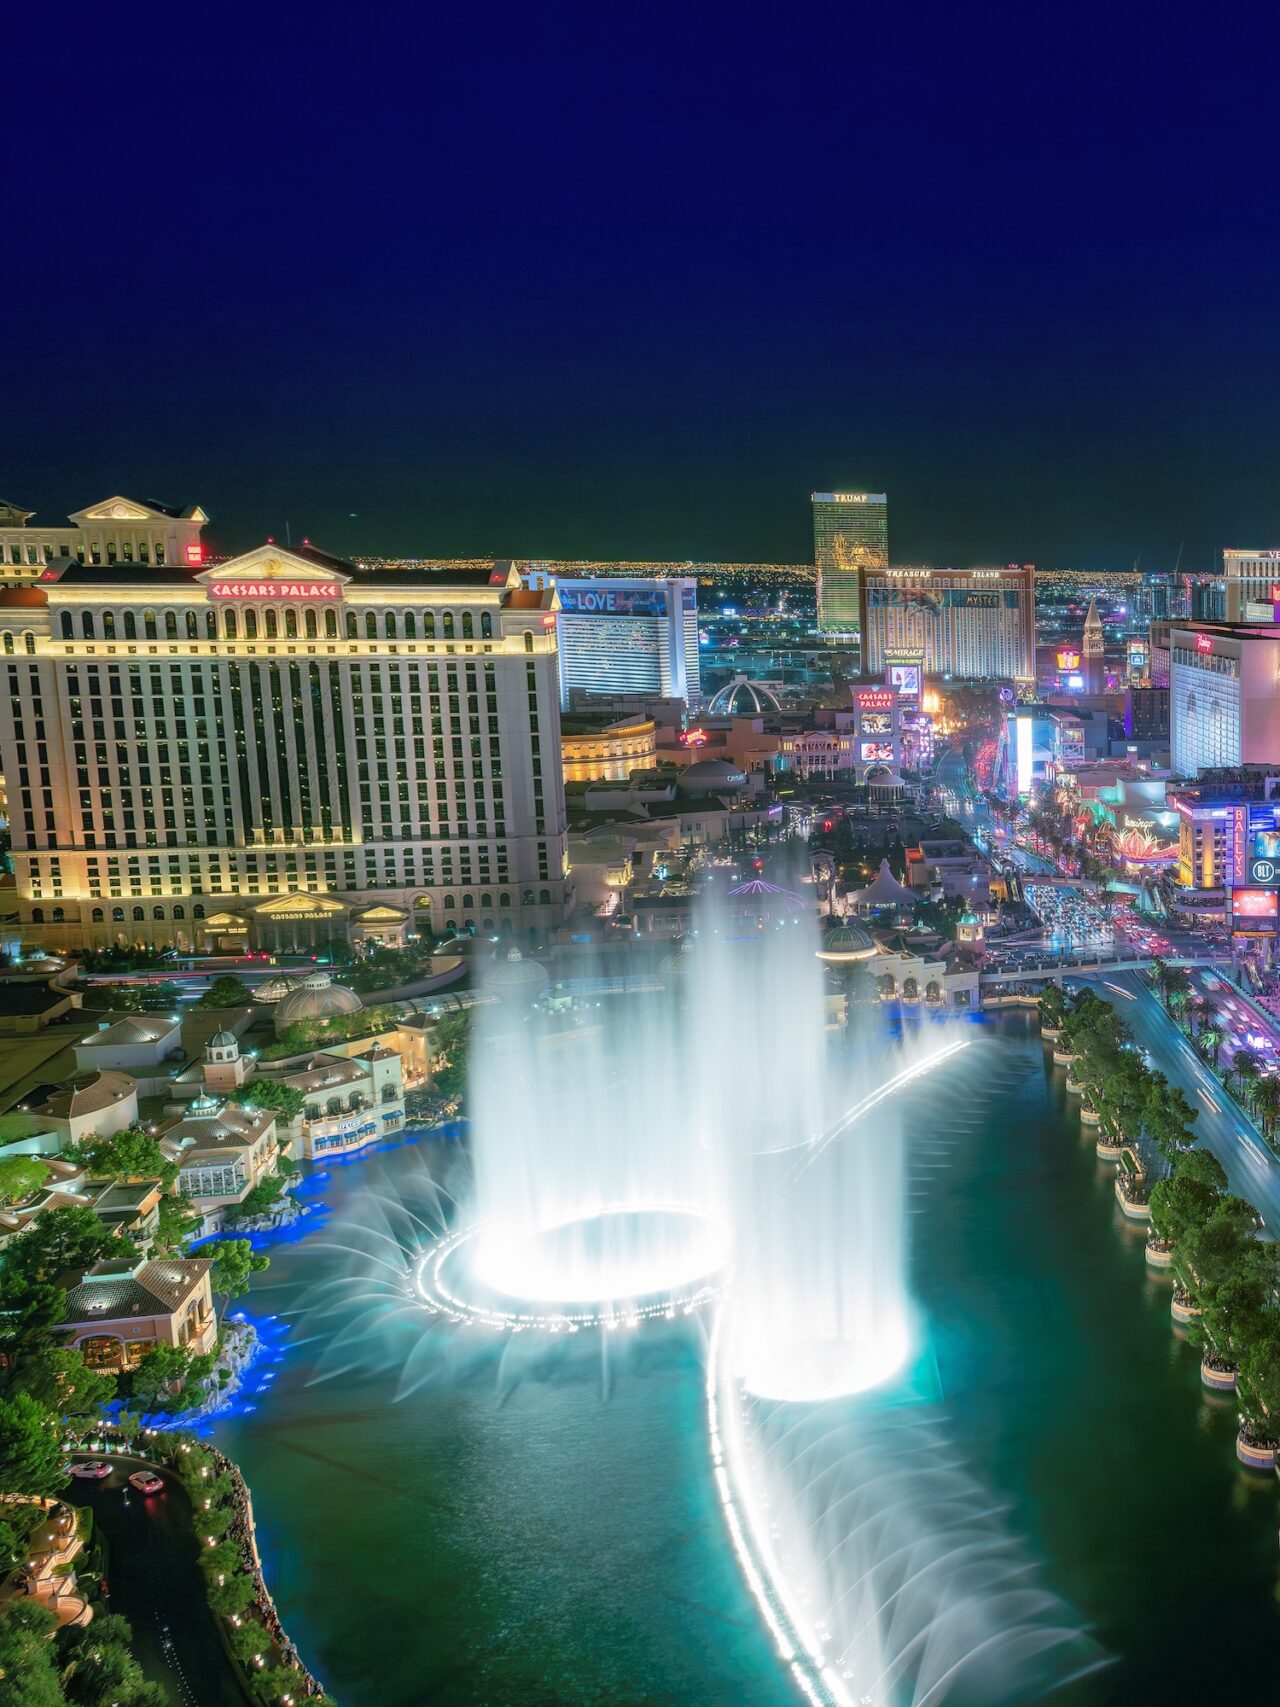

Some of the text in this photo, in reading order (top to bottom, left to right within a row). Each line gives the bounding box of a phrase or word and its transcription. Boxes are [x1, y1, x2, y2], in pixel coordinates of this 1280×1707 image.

[834, 494, 867, 502] TRUMP
[886, 570, 931, 578] TREASURE
[212, 584, 336, 596] CAESARS PALACE
[577, 592, 616, 611] LOVE
[893, 649, 924, 657] MIRAGE
[1257, 865, 1270, 877] BLT
